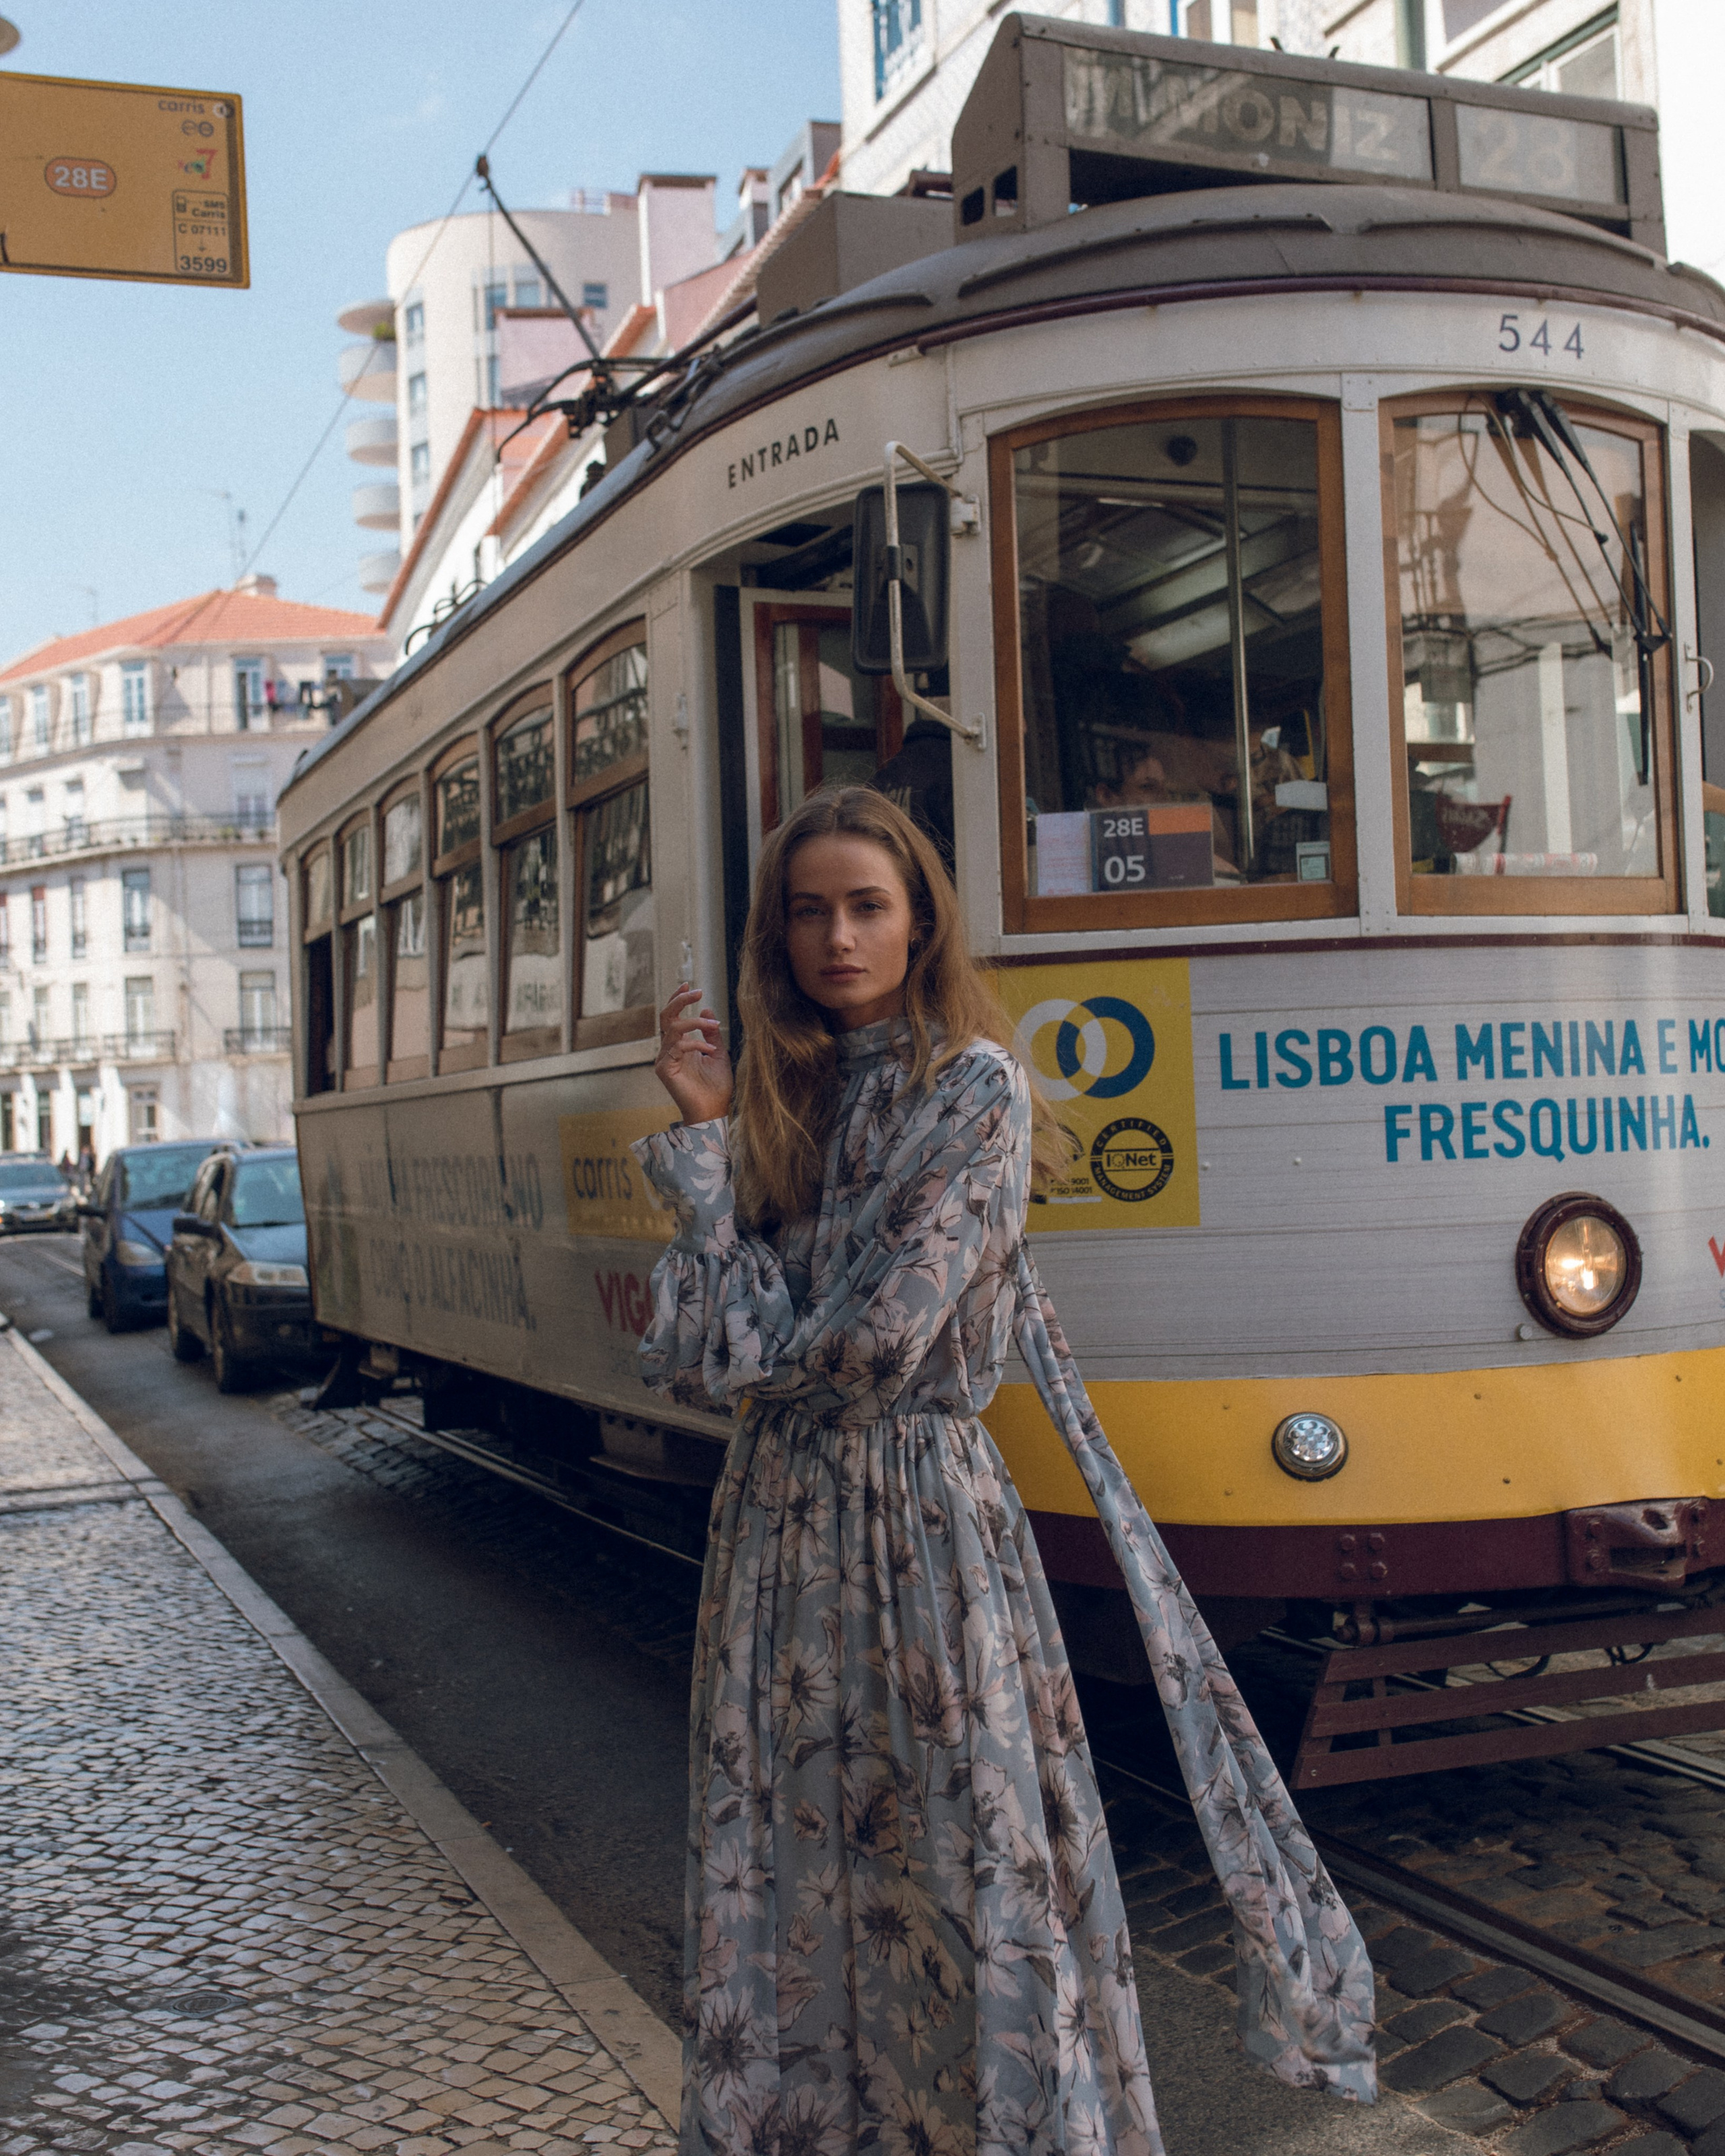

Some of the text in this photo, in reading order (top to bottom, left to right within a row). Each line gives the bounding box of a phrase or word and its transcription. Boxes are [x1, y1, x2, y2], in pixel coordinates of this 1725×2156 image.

[158, 100, 205, 114] carris
[1476, 110, 1574, 191] 28
[53, 165, 108, 191] 28E
[178, 222, 187, 234] C
[179, 255, 227, 274] 3599
[1499, 313, 1585, 360] 544
[728, 418, 840, 489] ENTRADA
[1103, 817, 1145, 839] 28E
[1104, 854, 1146, 885] 05
[1218, 1025, 1439, 1090] LISBOA
[1454, 1019, 1645, 1081] MENINA
[1656, 1018, 1679, 1075] E
[1096, 1120, 1168, 1148] CERTIFIED
[1383, 1093, 1710, 1163] FRESQUINHA.
[573, 1138, 633, 1200] carris
[1106, 1152, 1157, 1169] IQNet
[1094, 1166, 1146, 1200] MANAGEMENT
[1147, 1164, 1172, 1195] SYSTEM
